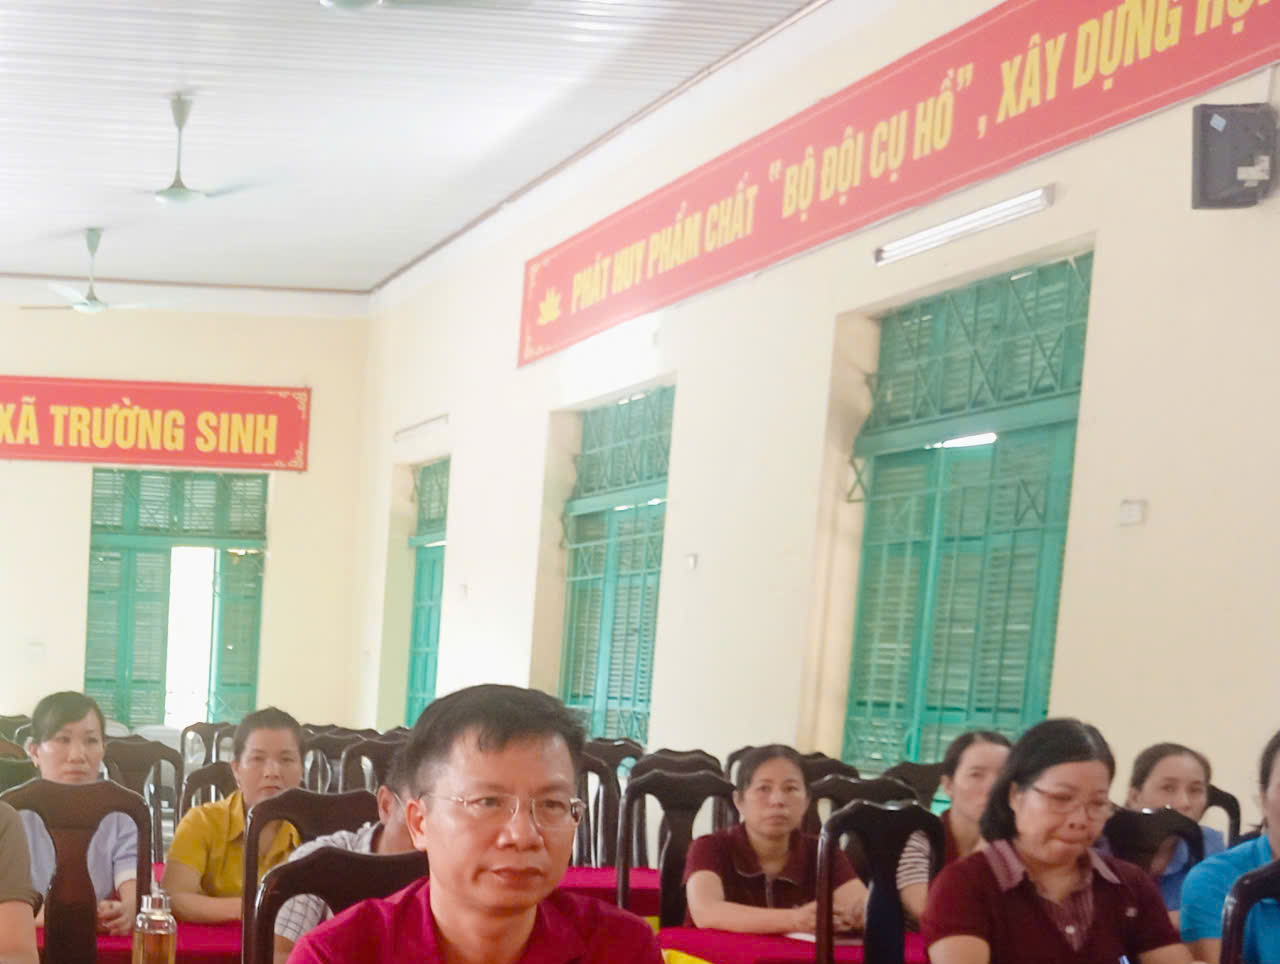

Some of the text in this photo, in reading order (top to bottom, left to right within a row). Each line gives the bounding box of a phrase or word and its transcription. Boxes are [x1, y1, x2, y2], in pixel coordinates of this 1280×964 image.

[570, 252, 611, 315] PHÁT
[611, 239, 647, 295] HUY
[647, 200, 704, 280] PHẨM
[705, 171, 759, 252] CHẤT
[818, 125, 865, 206] ĐỘI
[869, 109, 909, 184] CỤ
[996, 32, 1068, 125] XÂY
[50, 399, 185, 452] TRƯỜNG
[196, 411, 277, 455] SINH
